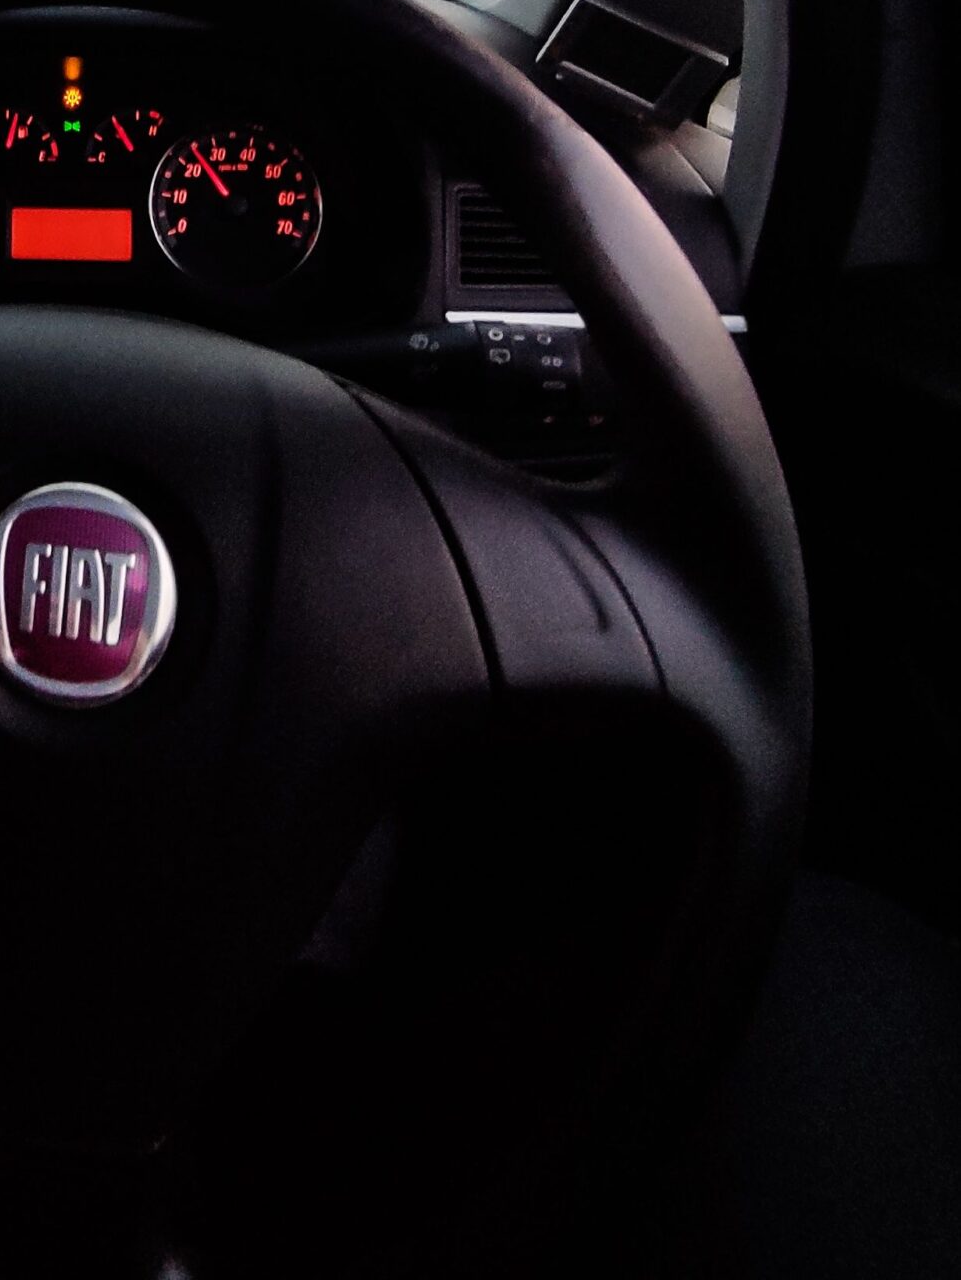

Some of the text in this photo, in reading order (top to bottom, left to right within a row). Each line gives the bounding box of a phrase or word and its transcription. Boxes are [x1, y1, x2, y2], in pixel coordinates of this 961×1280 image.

[209, 147, 226, 162] 30
[239, 147, 256, 162] 40
[184, 163, 201, 178] 20
[265, 164, 282, 179] 50
[173, 189, 187, 204] 10
[278, 191, 295, 206] 60
[177, 218, 187, 233] 0
[277, 220, 293, 235] 70
[19, 542, 136, 647] FIAT
